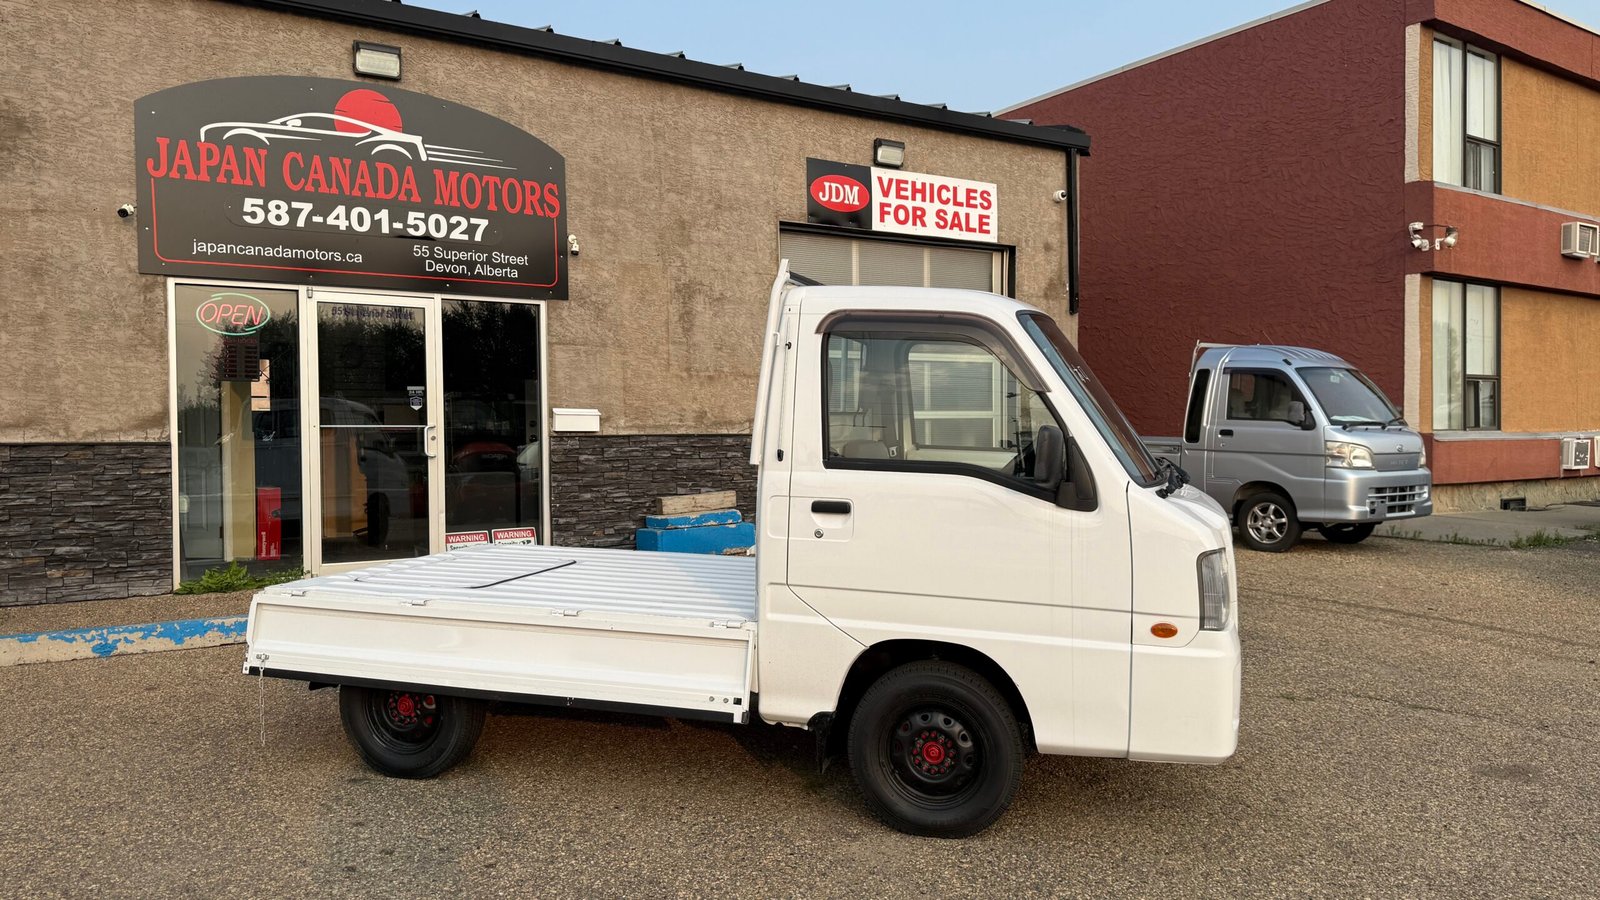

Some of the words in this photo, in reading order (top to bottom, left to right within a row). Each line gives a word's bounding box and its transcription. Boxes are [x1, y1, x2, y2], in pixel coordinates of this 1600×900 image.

[146, 137, 267, 187] JAPAN
[283, 151, 421, 203] CANADA
[433, 168, 560, 218] MOTORS
[819, 182, 859, 206] JDM
[877, 176, 992, 210] VEHICLES
[242, 197, 489, 242] 587-401-5027
[879, 202, 927, 227] FOR
[935, 208, 990, 234] SALE
[192, 238, 363, 263] japancanadamotors.ca
[413, 245, 429, 258] 55
[433, 246, 487, 262] Superior
[491, 251, 529, 266] Street
[425, 259, 471, 276] Devon,
[474, 264, 518, 278] Alberta
[200, 303, 263, 325] OPEN
[448, 534, 485, 543] WARNING
[496, 530, 532, 539] WARNING
